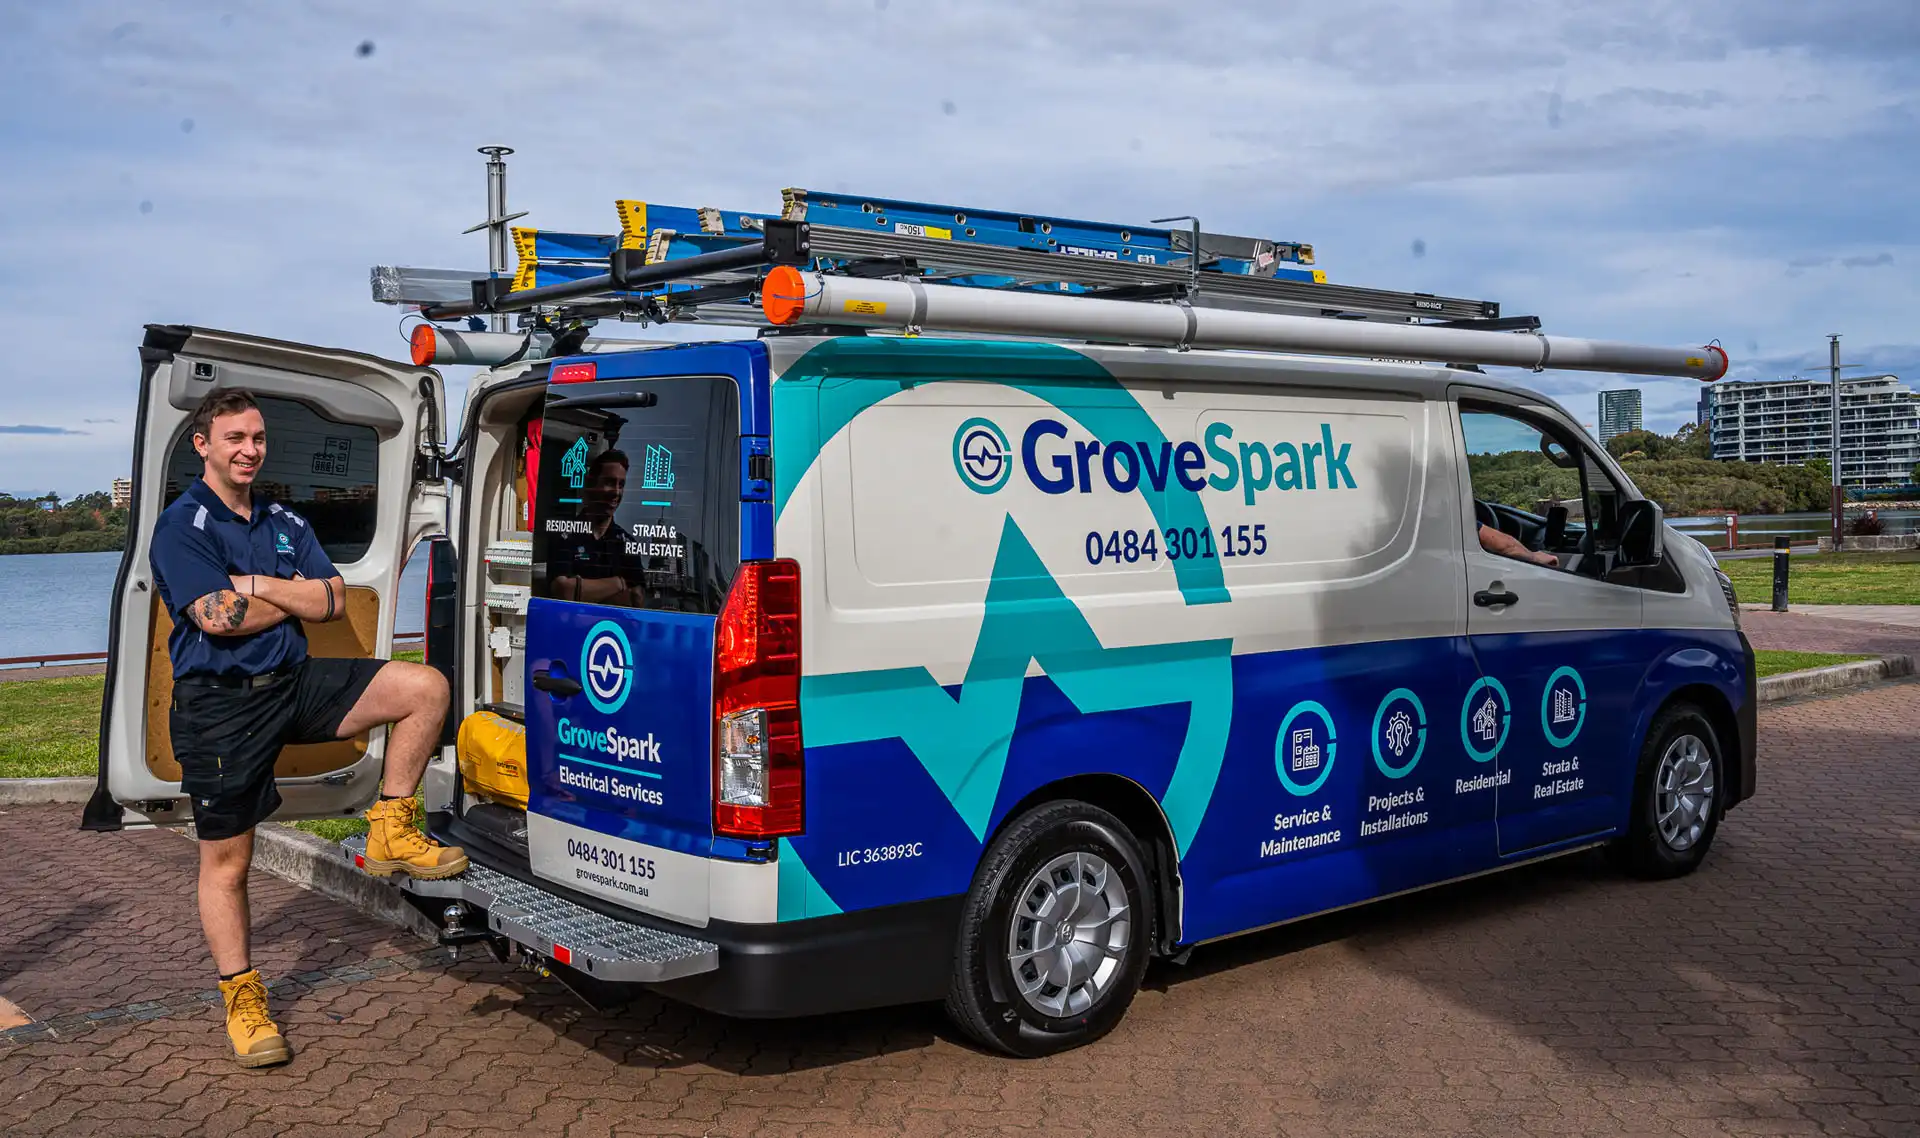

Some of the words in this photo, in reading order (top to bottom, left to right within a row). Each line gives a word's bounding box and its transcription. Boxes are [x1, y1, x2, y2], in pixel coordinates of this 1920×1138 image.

[907, 225, 921, 235] 150
[1021, 418, 1358, 505] GroveSpark
[546, 519, 592, 534] RESIDENTIAL
[632, 524, 669, 538] STRATA
[669, 525, 676, 539] &
[625, 542, 648, 556] REAL
[649, 544, 683, 558] ESTATE
[1085, 528, 1158, 565] 0484
[1164, 526, 1215, 560] 301
[1221, 524, 1267, 557] 155
[557, 717, 662, 764] GroveSpark
[1542, 759, 1571, 776] Strata
[1571, 756, 1579, 771] &
[559, 765, 609, 795] Electrical
[611, 777, 663, 806] Services
[1455, 769, 1511, 794] Residential
[1534, 783, 1555, 800] Real
[1555, 777, 1584, 795] Estate
[1368, 789, 1415, 812] Projects
[1416, 787, 1425, 802] &
[1274, 808, 1321, 831] Service
[1321, 805, 1332, 821] &
[1360, 810, 1429, 837] Installations
[838, 850, 861, 867] LIC
[863, 842, 923, 863] 363893C
[1260, 827, 1341, 858] Maintenance
[567, 838, 599, 865] 0484
[601, 848, 626, 873] 301
[630, 855, 656, 880] 155
[576, 866, 649, 897] grovespark.com.au
